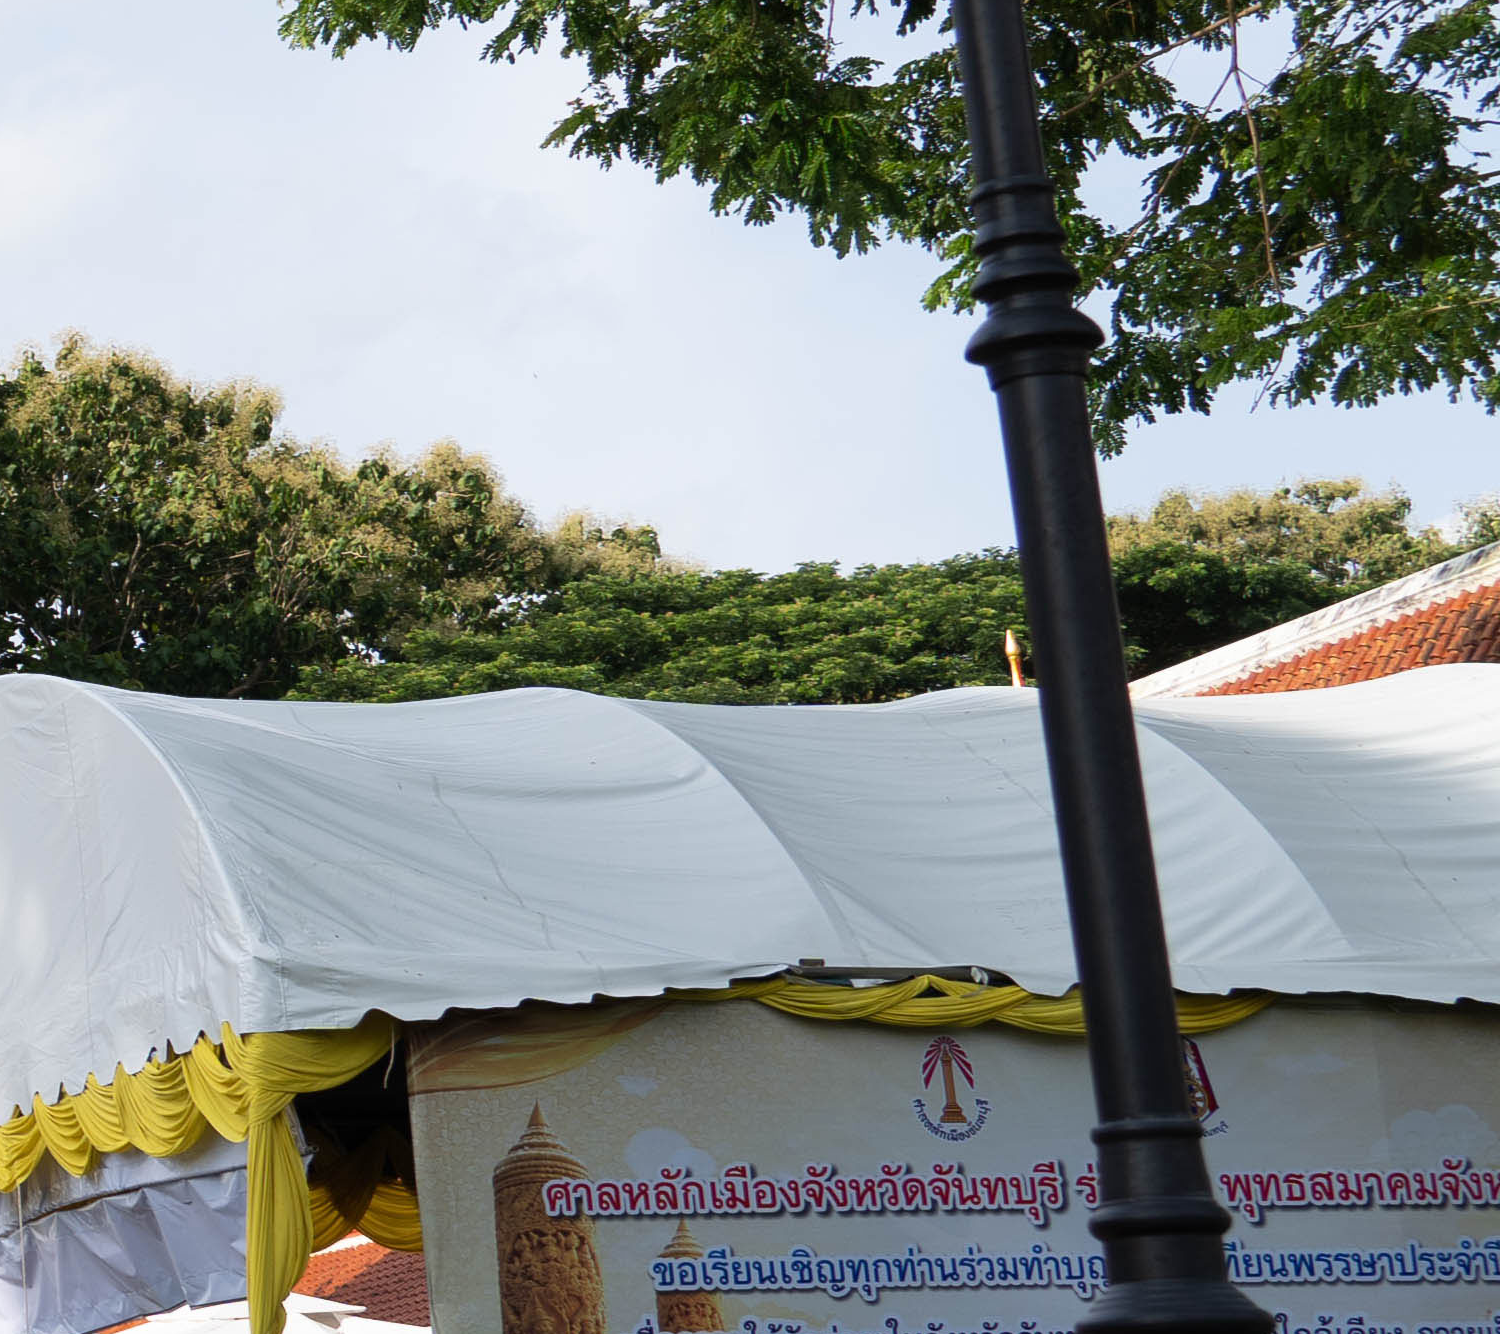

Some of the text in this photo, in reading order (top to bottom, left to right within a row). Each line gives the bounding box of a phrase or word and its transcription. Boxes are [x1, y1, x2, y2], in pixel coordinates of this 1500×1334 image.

[545, 1163, 1060, 1222] ศาลหลักเมืองจังหวัดจันทบุรี
